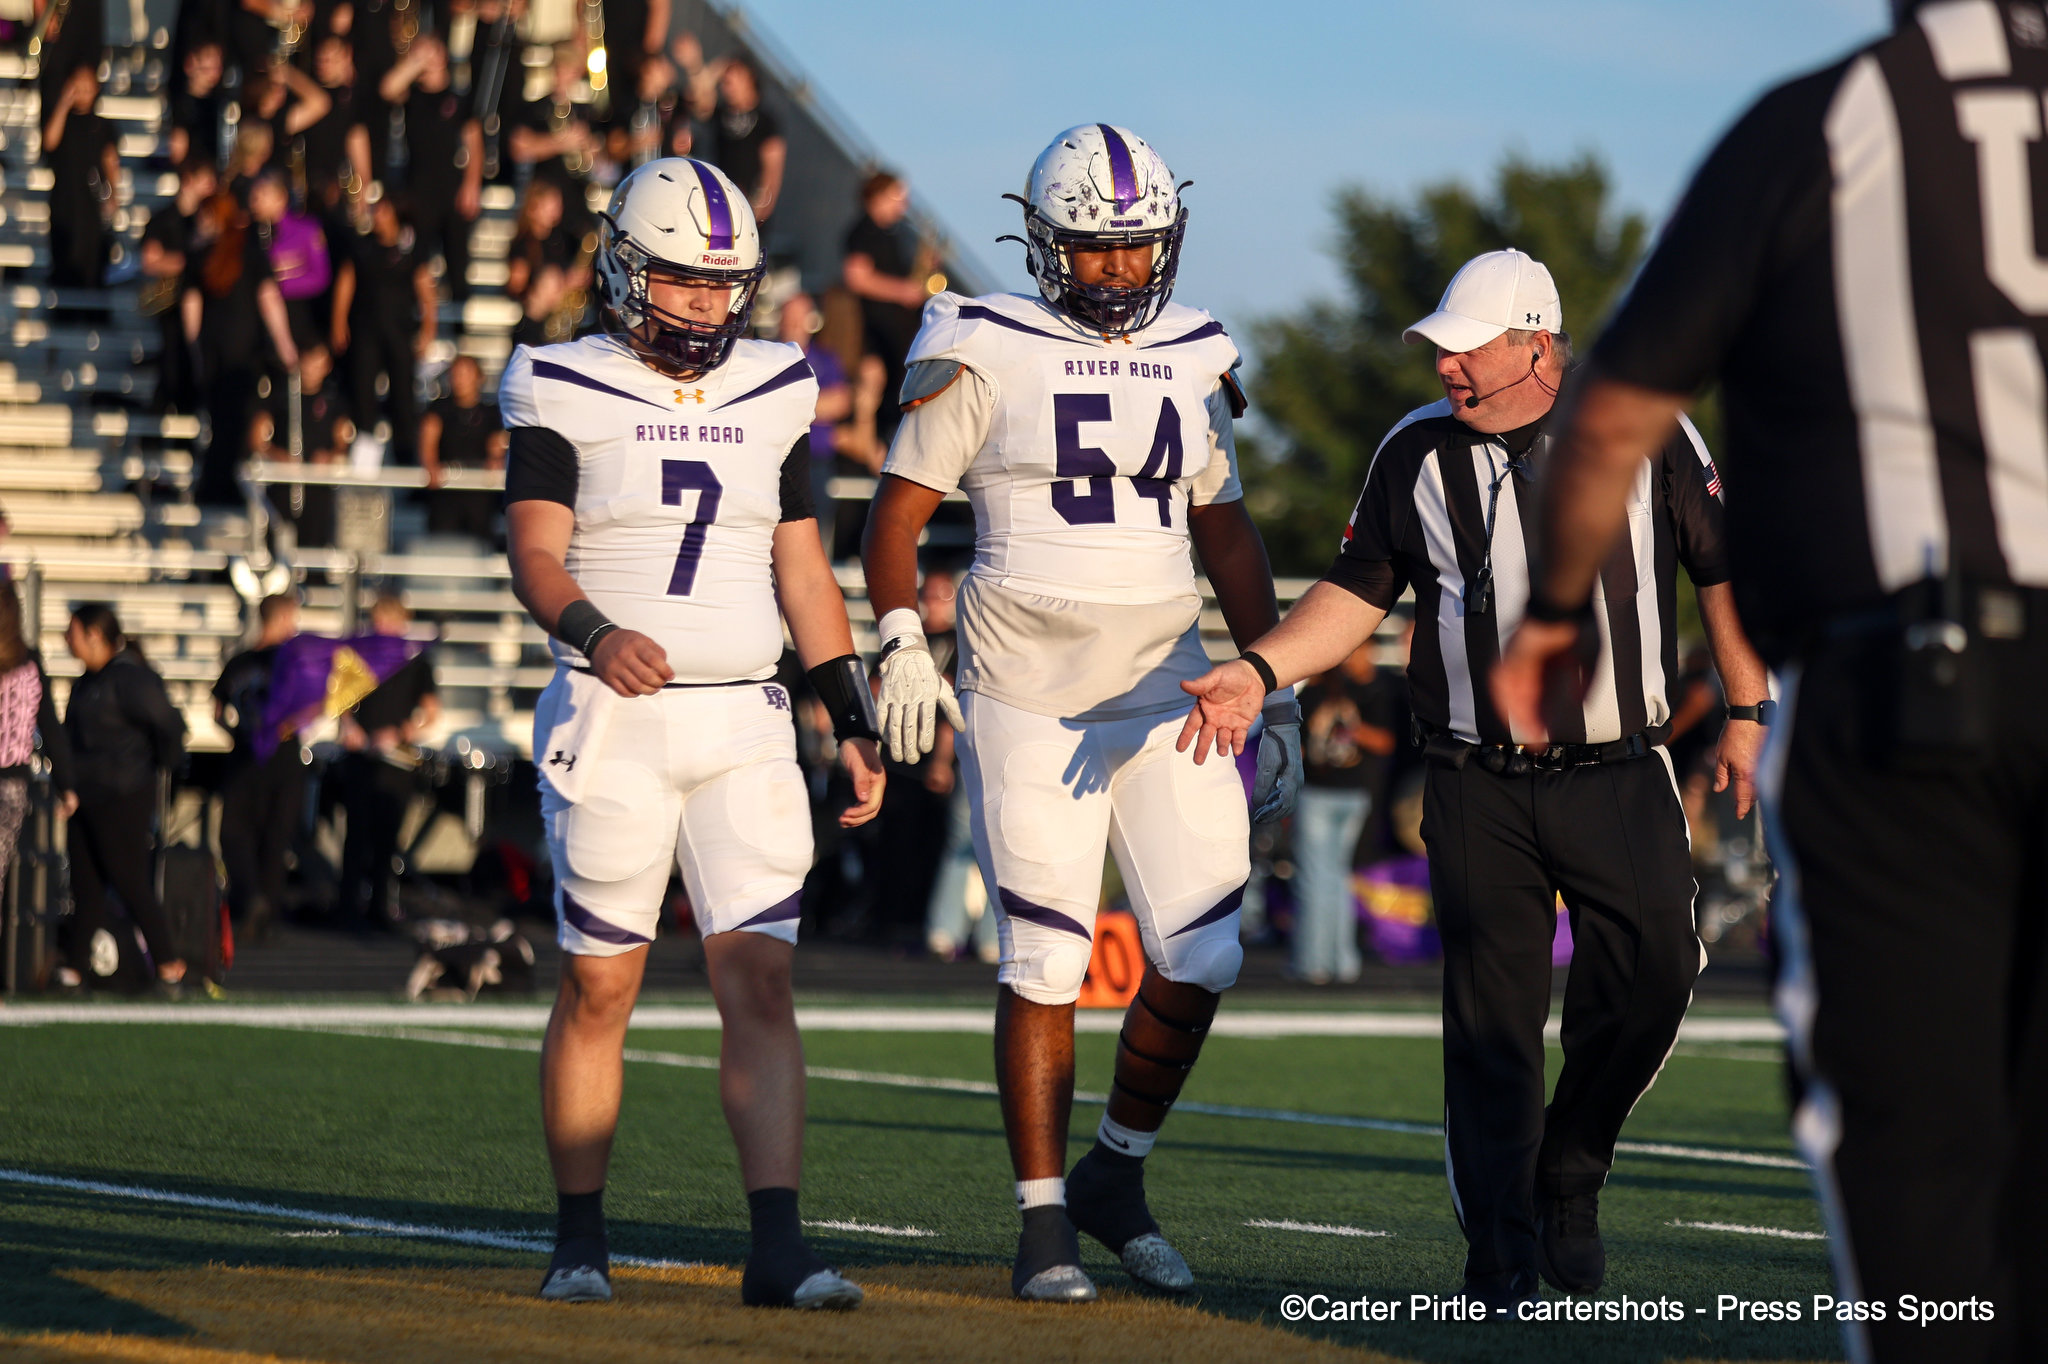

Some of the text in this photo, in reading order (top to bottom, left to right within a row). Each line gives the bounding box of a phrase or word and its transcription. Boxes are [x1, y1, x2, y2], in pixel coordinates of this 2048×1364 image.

[702, 254, 739, 266] Riddell
[1064, 360, 1173, 381] RIVER ROAD
[636, 425, 744, 444] RIVER ROAD
[1050, 393, 1183, 528] 54
[661, 459, 724, 597] 7
